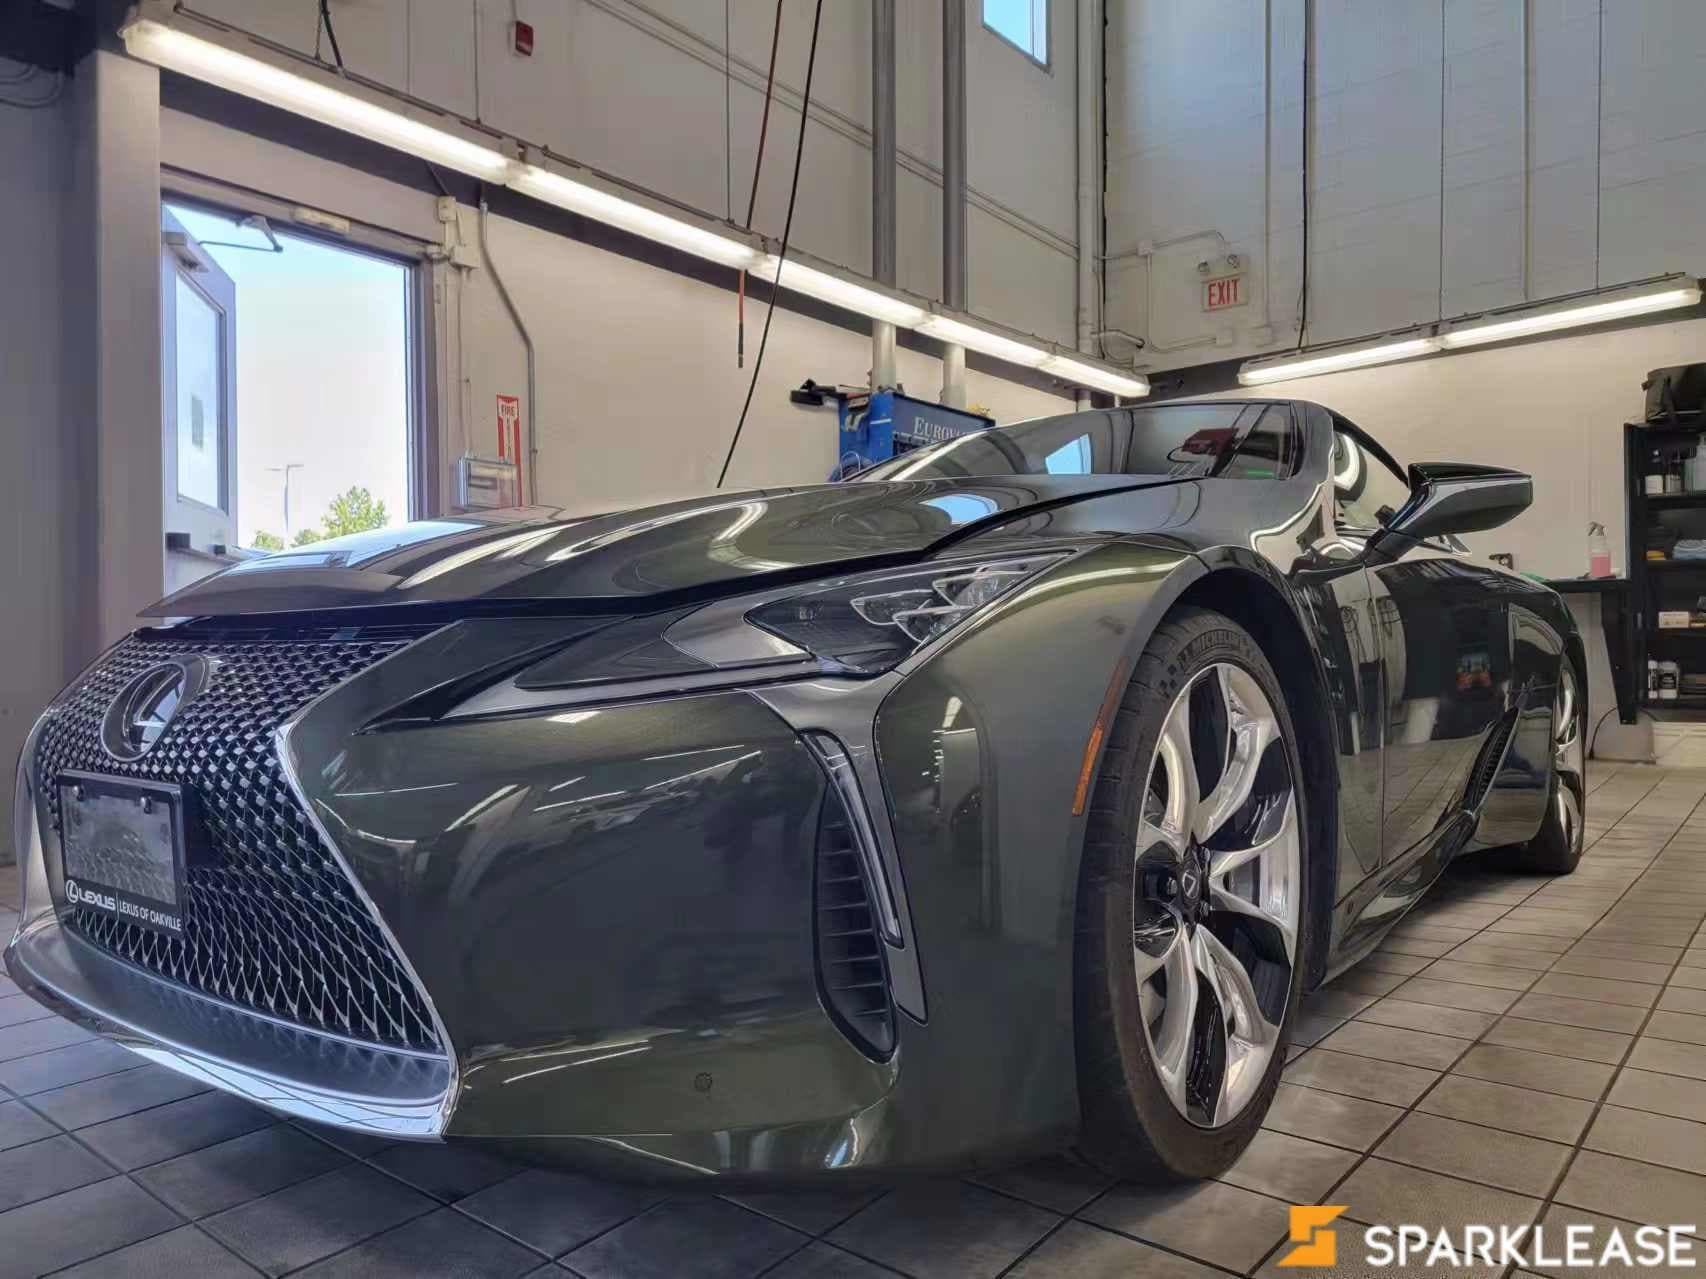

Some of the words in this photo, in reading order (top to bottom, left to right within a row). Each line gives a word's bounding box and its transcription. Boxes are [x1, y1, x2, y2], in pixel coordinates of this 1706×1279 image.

[1208, 279, 1239, 305] EXIT
[501, 404, 515, 417] FIRE
[79, 887, 116, 911] LEXUS
[120, 900, 139, 918] LEXUS
[140, 907, 149, 921] OF
[150, 910, 182, 932] OAKVILLE
